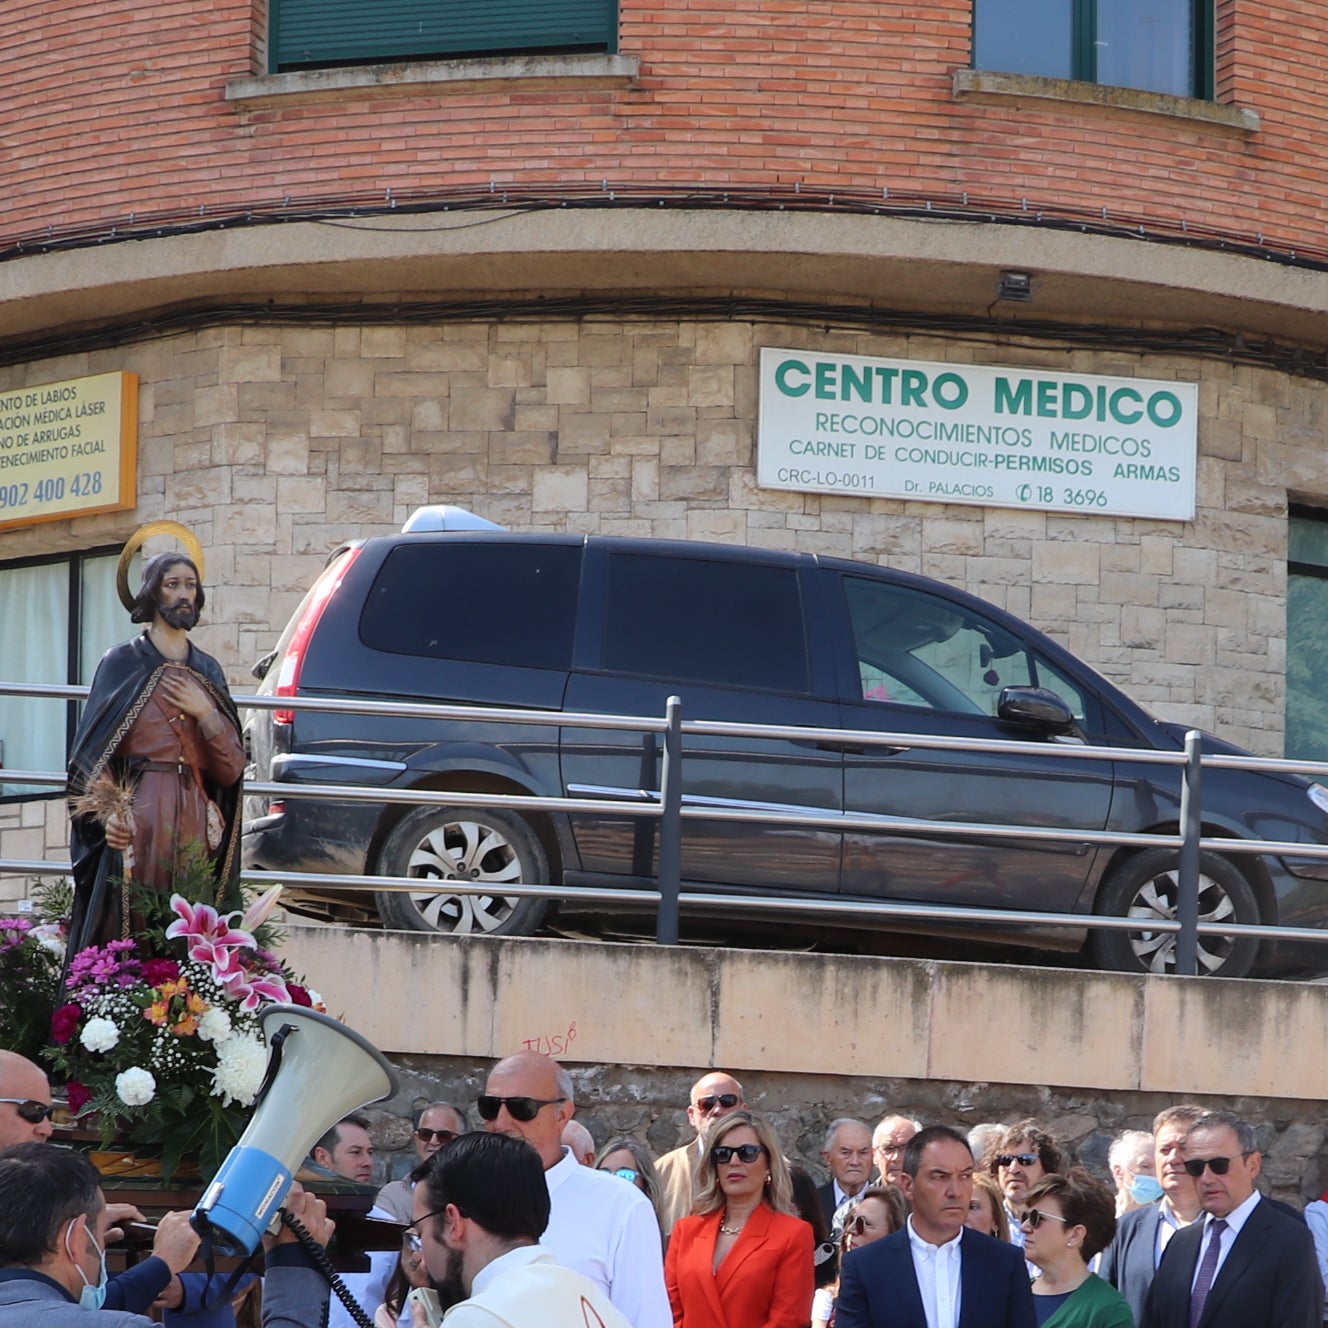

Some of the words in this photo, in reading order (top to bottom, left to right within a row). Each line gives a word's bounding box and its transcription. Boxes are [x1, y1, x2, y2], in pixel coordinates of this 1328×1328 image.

[25, 392, 38, 408] DE
[40, 386, 77, 405] LABIOS
[775, 359, 969, 410] CENTRO
[994, 377, 1183, 428] MEDICO
[32, 406, 73, 427] MÉDICA
[75, 399, 106, 419] LÁSER
[16, 433, 30, 448] DE
[32, 424, 82, 445] ARRUGAS
[71, 440, 106, 460] FACIAL
[816, 412, 1033, 448] RECONOCIMIENTOS
[1050, 431, 1152, 458] MEDICOS
[789, 439, 856, 459] CARNET
[865, 445, 886, 461] DE
[1114, 463, 1181, 483] ARMAS
[34, 476, 65, 503] 400
[70, 471, 102, 498] 428
[777, 468, 876, 489] CRC-LO-0011
[904, 480, 923, 493] Dr.
[928, 481, 994, 498] PALACIOS
[1037, 486, 1054, 503] 18
[1063, 489, 1108, 507] 3696
